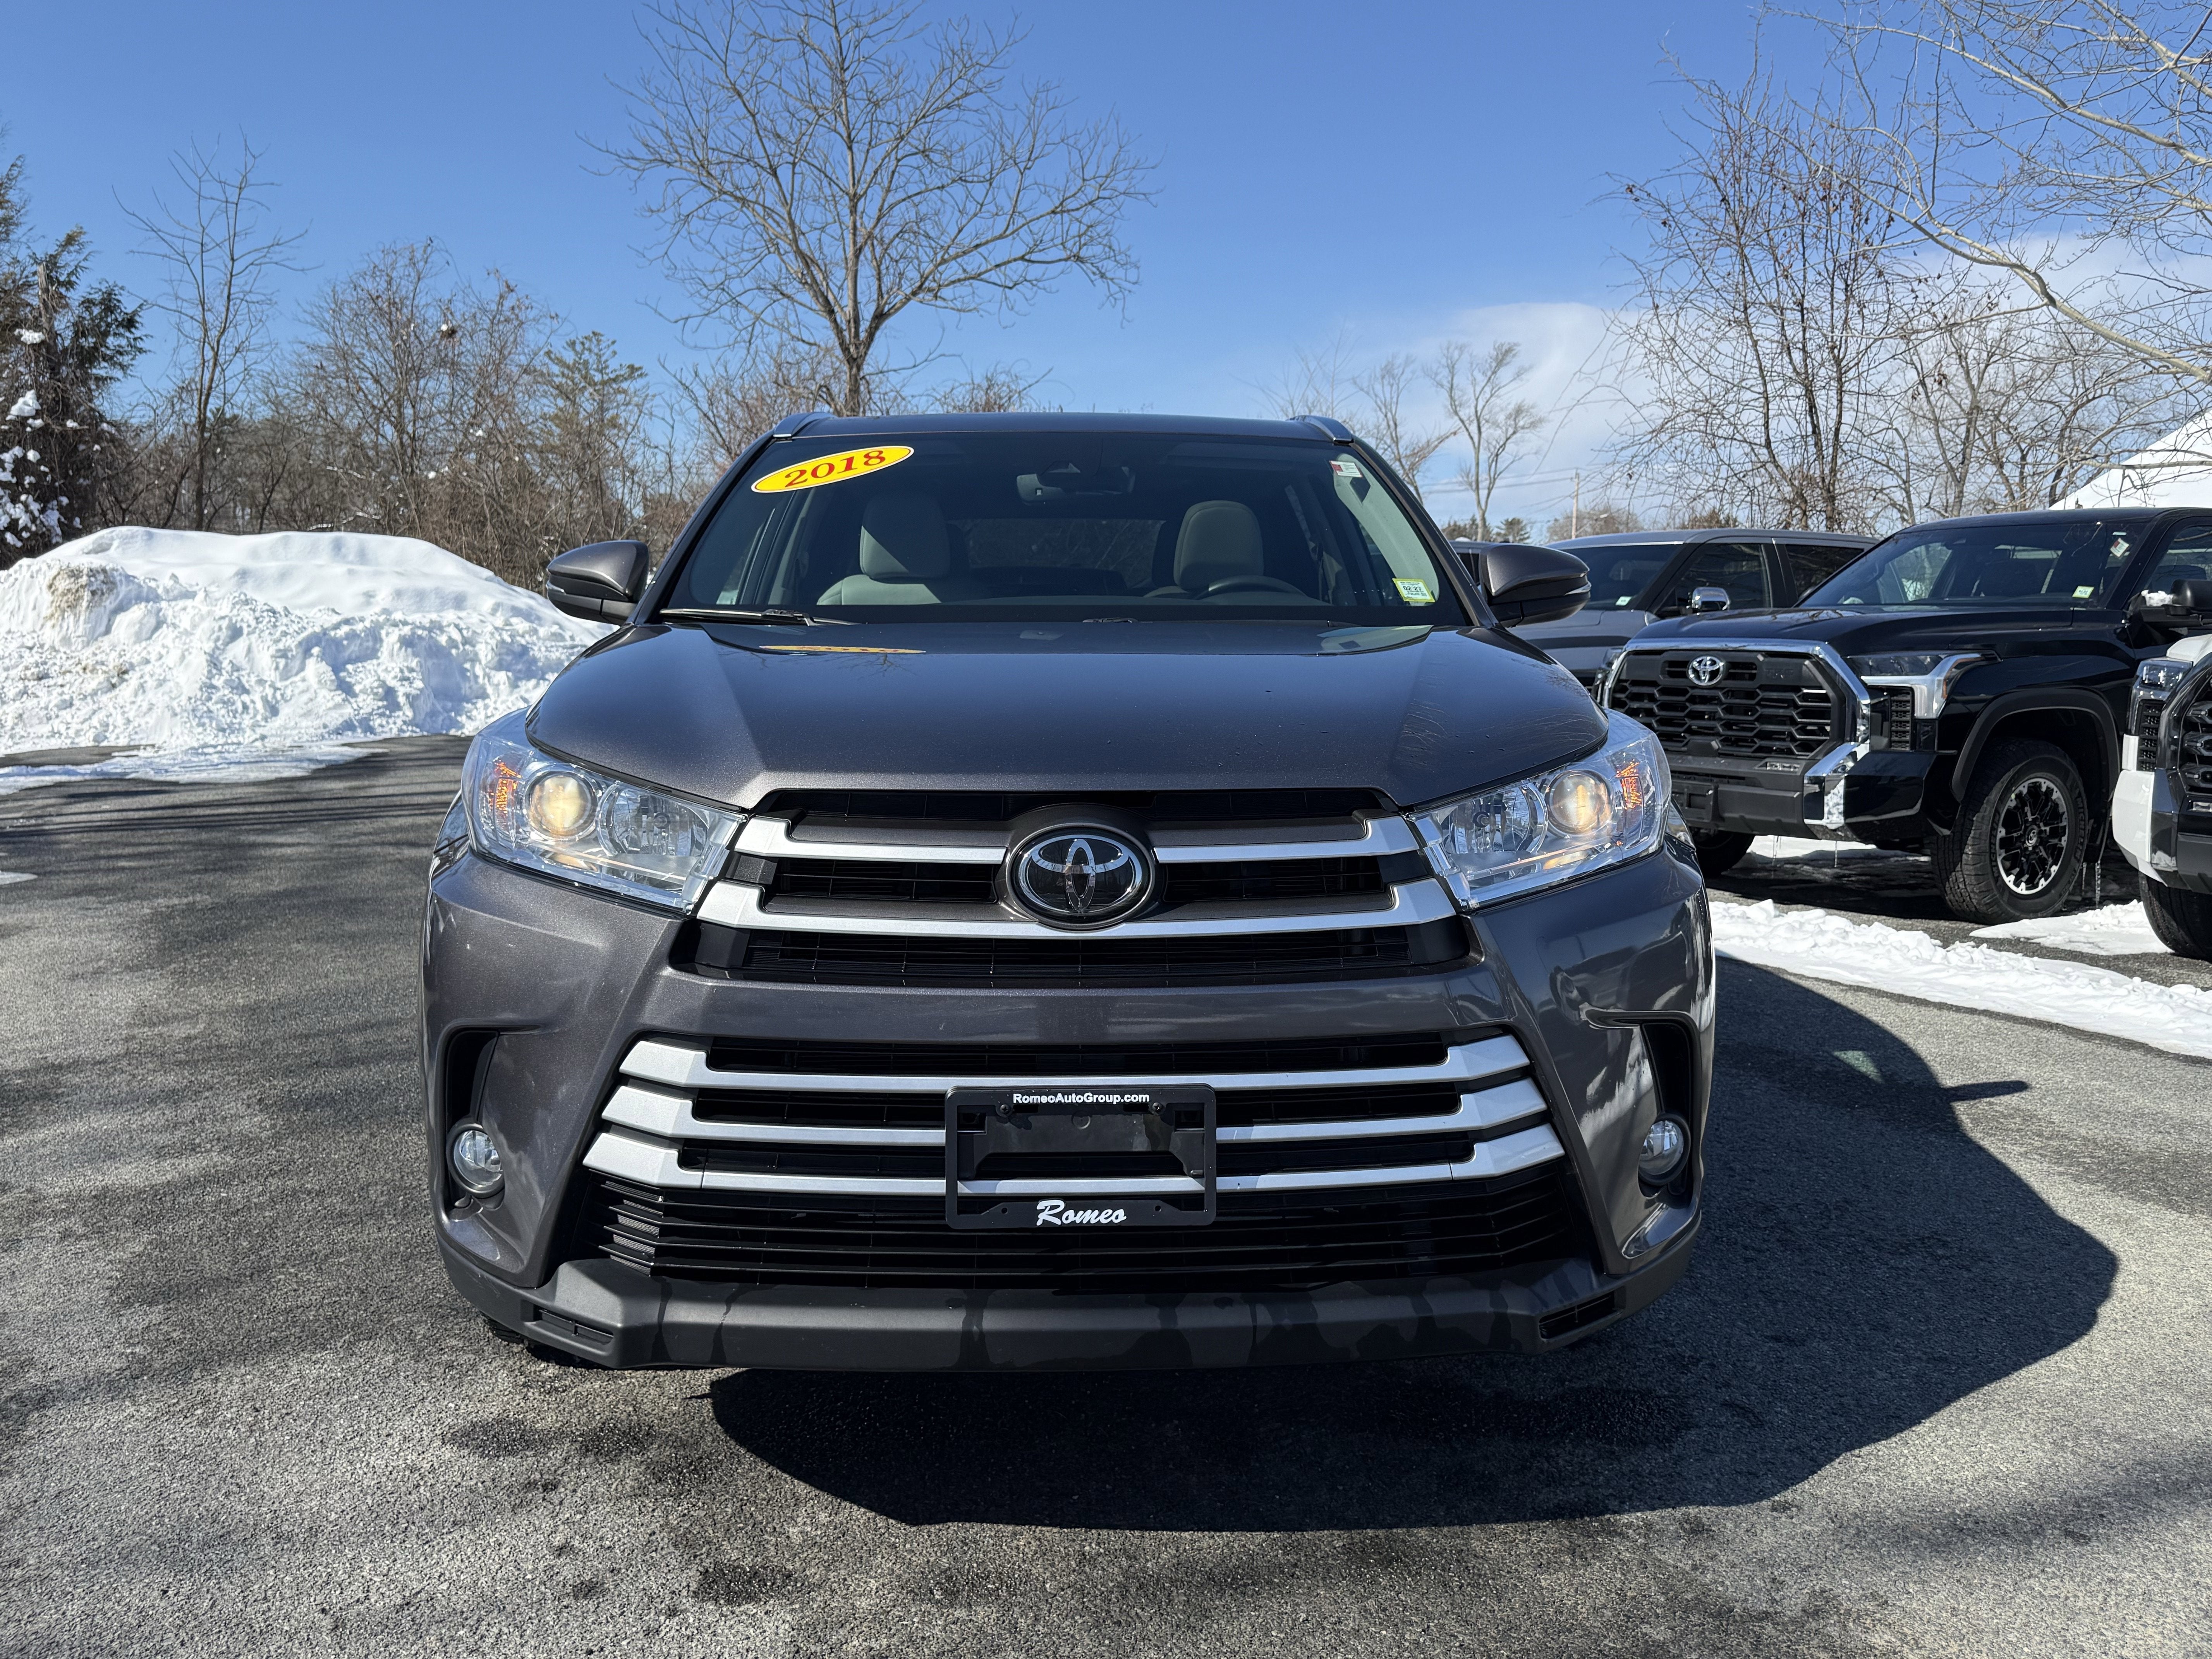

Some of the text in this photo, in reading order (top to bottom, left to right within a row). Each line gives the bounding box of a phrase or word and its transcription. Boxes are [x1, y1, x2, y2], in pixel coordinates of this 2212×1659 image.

[785, 450, 886, 488] 2018
[2075, 797, 2084, 859] MICHELIN
[1013, 1092, 1150, 1104] RomeoAutoGroup.com
[1036, 1200, 1127, 1226] Romeo
